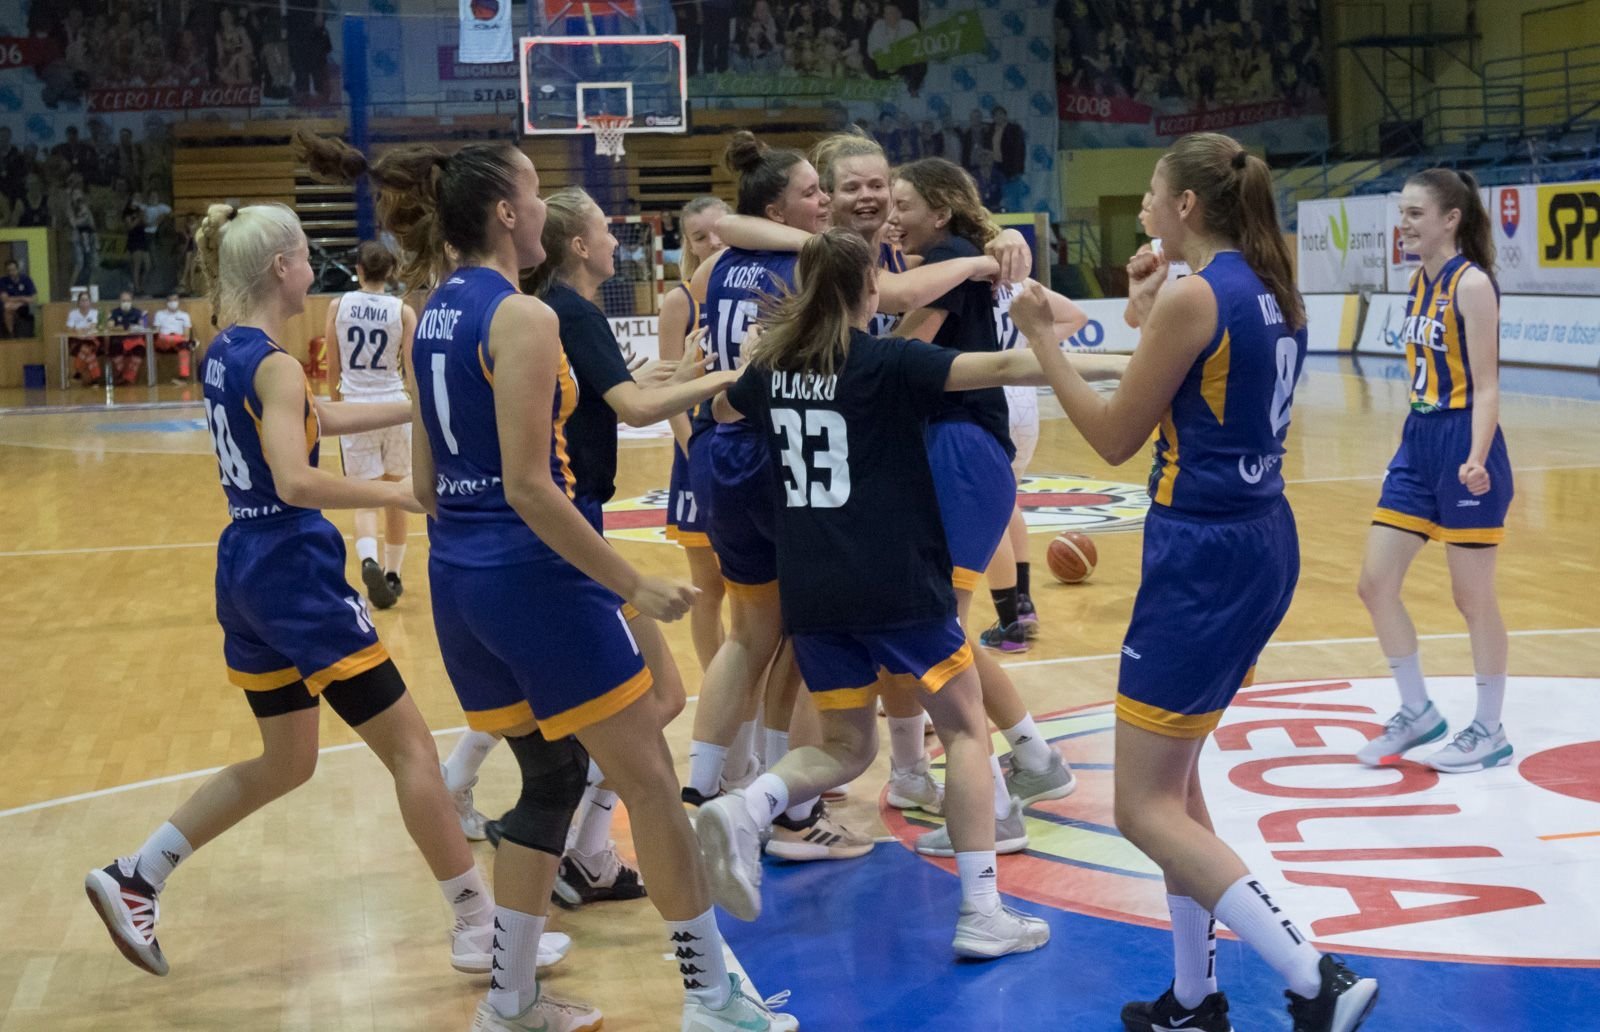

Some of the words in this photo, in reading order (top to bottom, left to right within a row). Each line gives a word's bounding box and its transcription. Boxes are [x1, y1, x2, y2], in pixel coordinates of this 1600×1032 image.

[911, 30, 961, 57] 2007
[102, 91, 149, 108] CERO
[1066, 94, 1112, 118] 2008
[1301, 225, 1328, 251] hotel
[1545, 192, 1600, 261] SPP
[350, 305, 388, 322] SLAVIA
[417, 302, 462, 341] KOŠICE
[347, 325, 389, 370] 22
[771, 367, 838, 401] PLAČKO
[1414, 356, 1427, 390] 7
[431, 353, 459, 455] 1
[769, 407, 851, 508] 33
[676, 489, 698, 523] 17
[1213, 682, 1546, 937] VEOLIA
